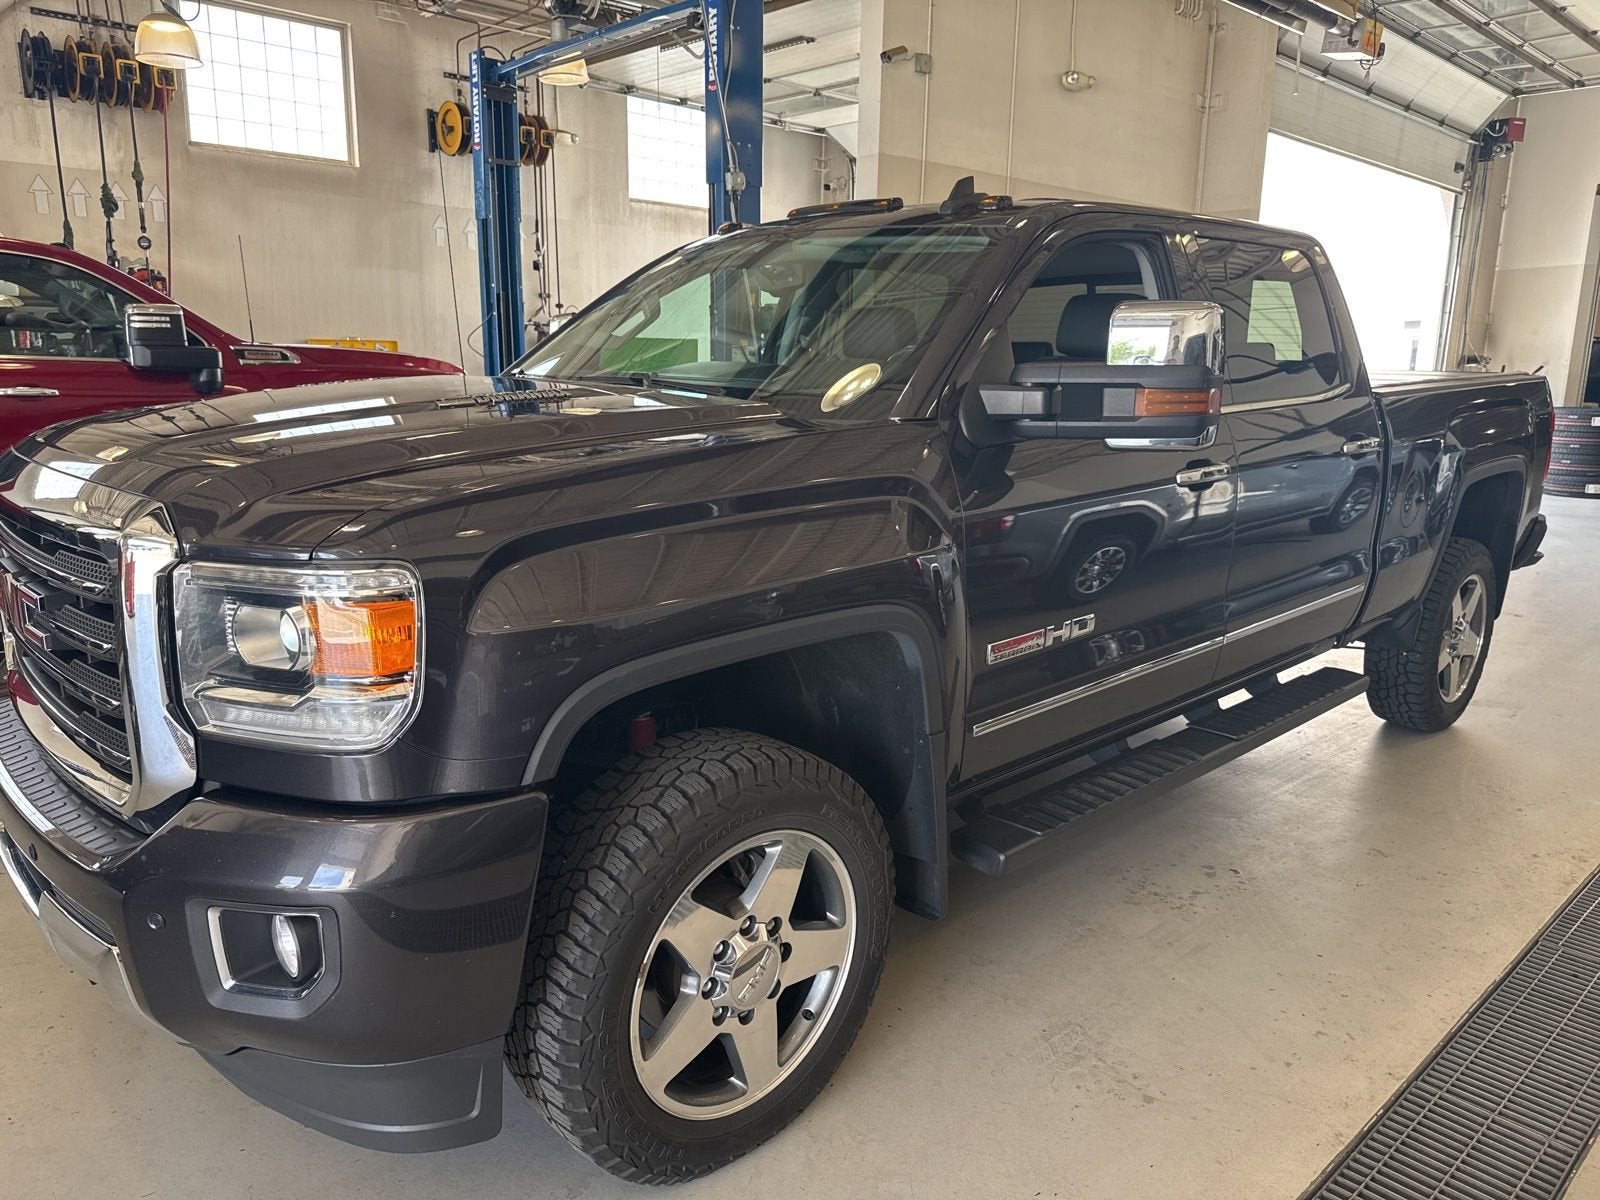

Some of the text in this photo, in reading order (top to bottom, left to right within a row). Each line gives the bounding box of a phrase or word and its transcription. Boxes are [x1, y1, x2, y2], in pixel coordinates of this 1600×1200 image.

[708, 7, 718, 82] ROTARY
[471, 53, 481, 143] ROTARY LIFT
[1045, 613, 1096, 648] HD
